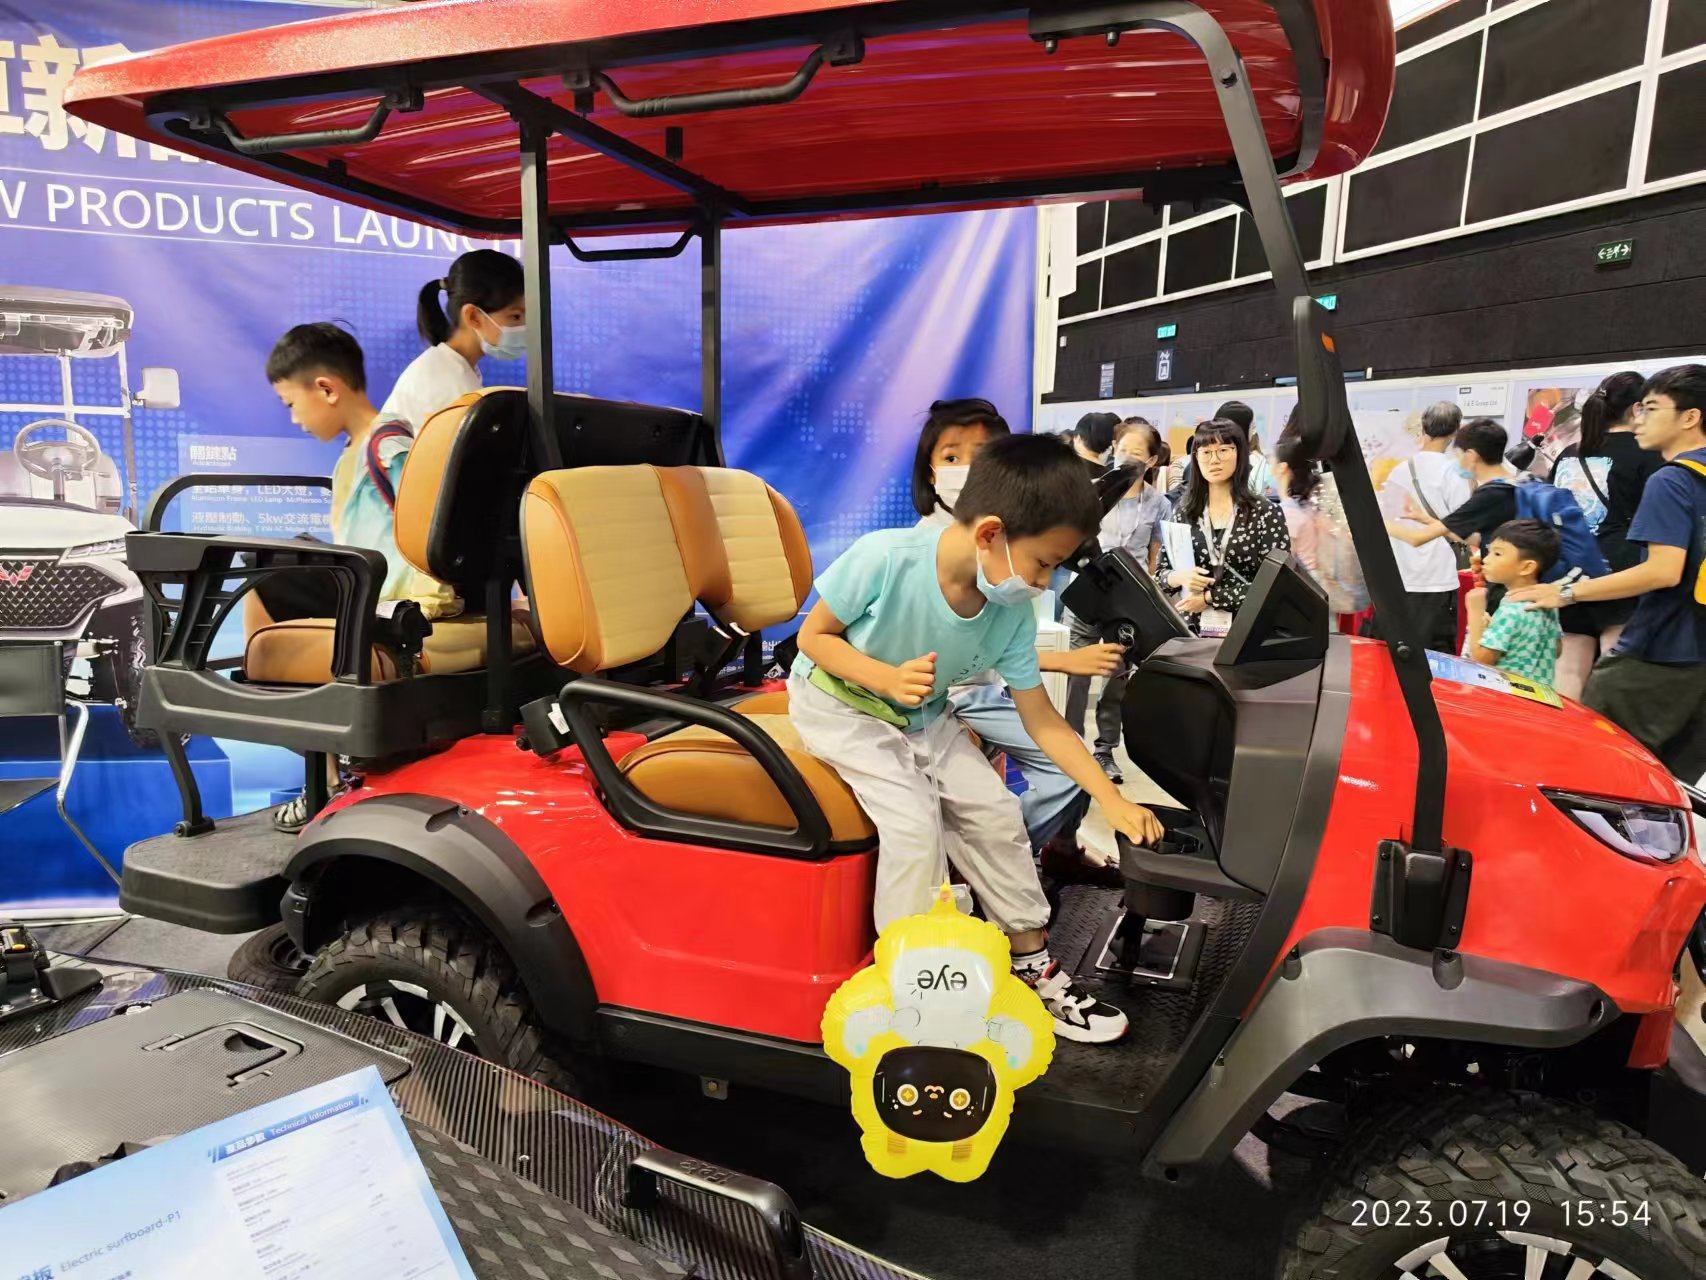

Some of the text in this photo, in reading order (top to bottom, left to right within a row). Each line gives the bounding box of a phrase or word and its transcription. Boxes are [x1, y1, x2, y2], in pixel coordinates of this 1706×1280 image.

[47, 183, 315, 239] PRODUCTS
[334, 205, 521, 258] LAUN
[917, 964, 967, 991] eye
[270, 1117, 308, 1137] Technical
[309, 1100, 354, 1121] Information
[60, 1247, 104, 1273] Electric
[106, 1209, 181, 1252] surfboard-P1
